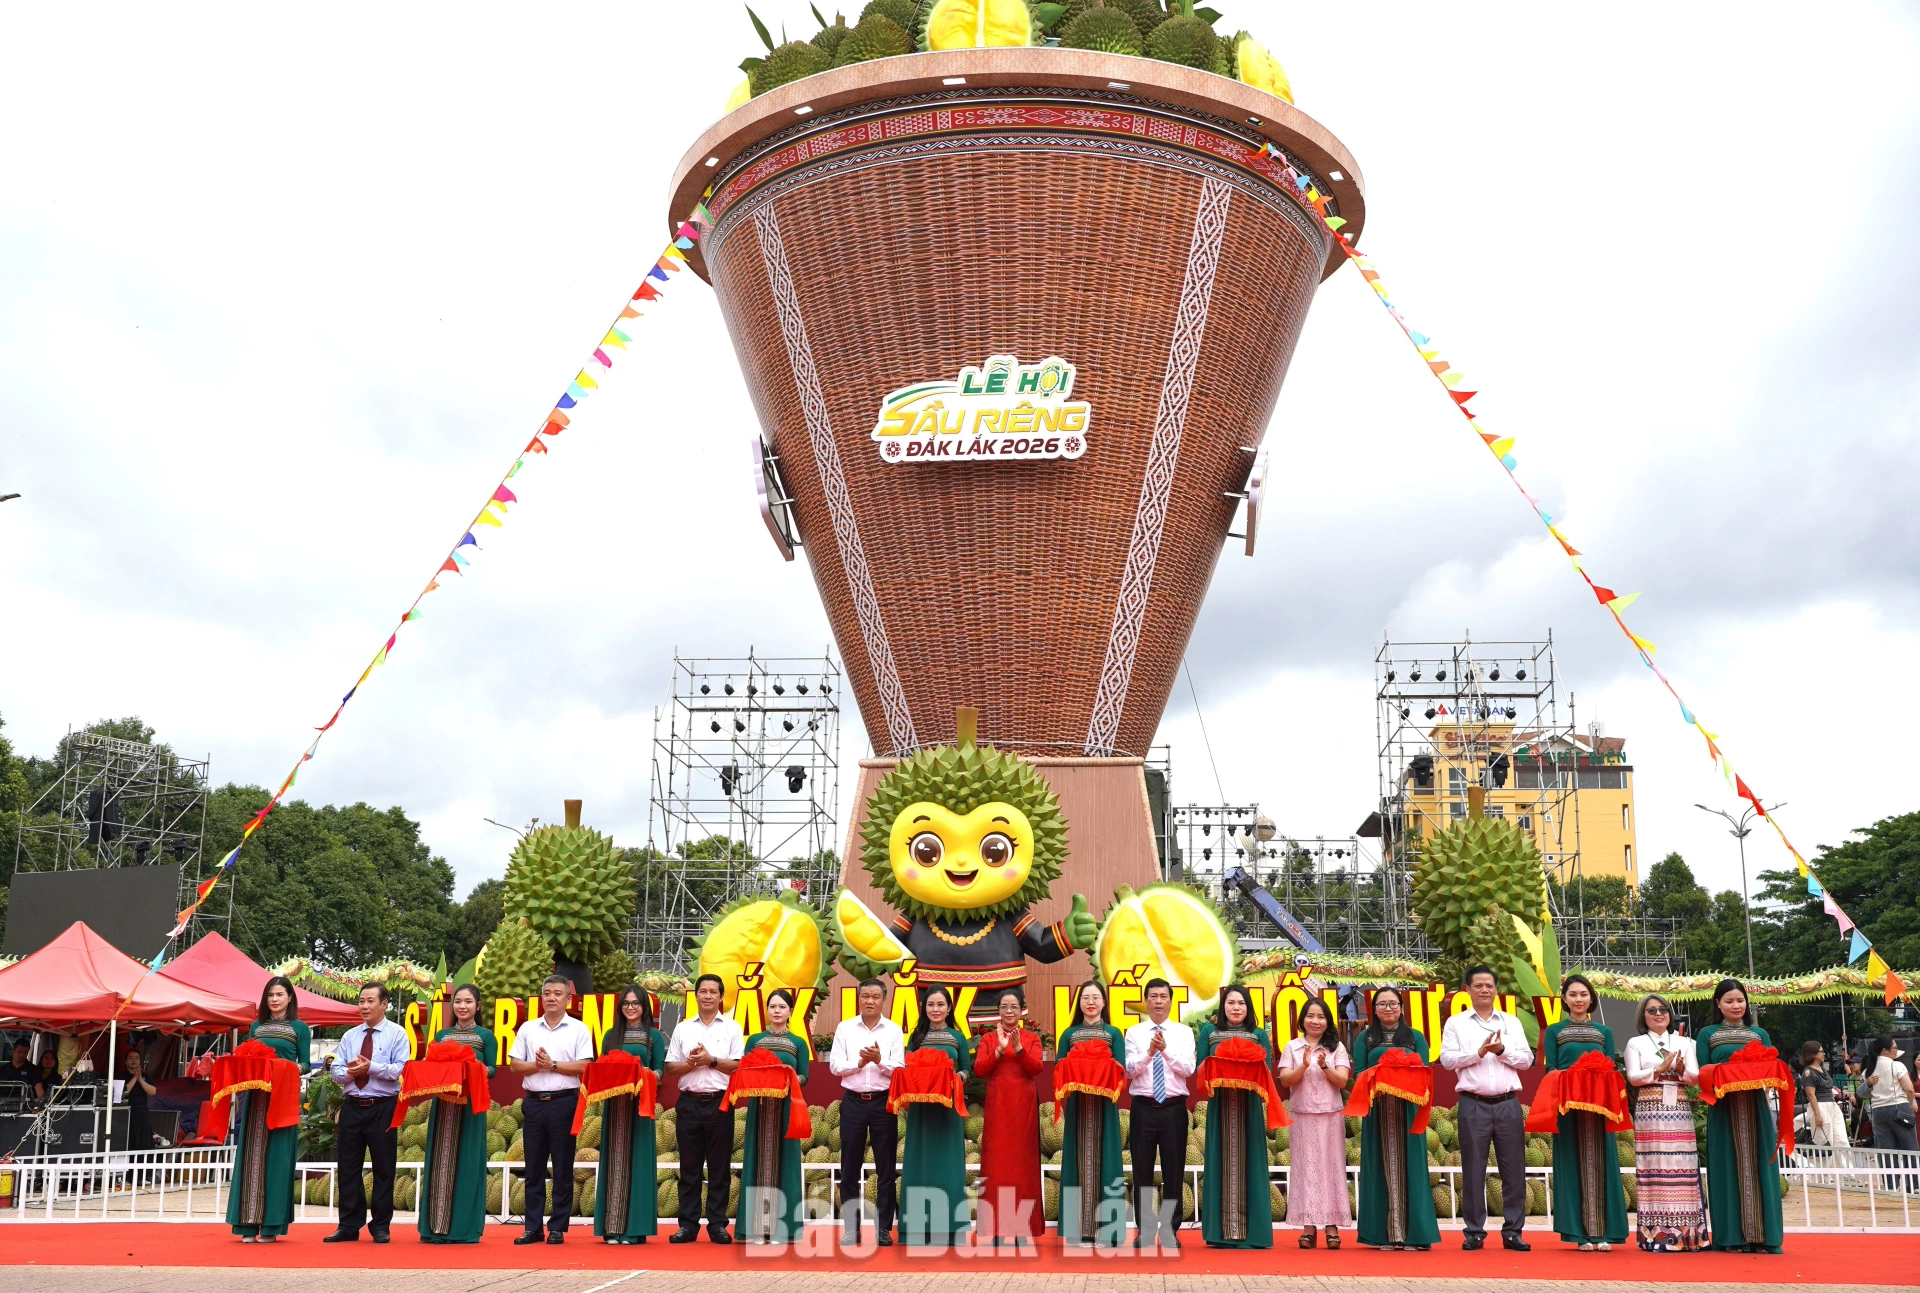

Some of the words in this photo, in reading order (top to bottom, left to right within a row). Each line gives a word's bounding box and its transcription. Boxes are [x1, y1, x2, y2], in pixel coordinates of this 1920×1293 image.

[962, 360, 1011, 394] LỄ
[1017, 364, 1072, 397] HỘI
[877, 400, 966, 436] SẦU
[972, 401, 1087, 434] RIÊNG
[906, 434, 953, 457] ĐẮK
[955, 434, 1000, 456] LẮK
[1000, 437, 1061, 455] 2026
